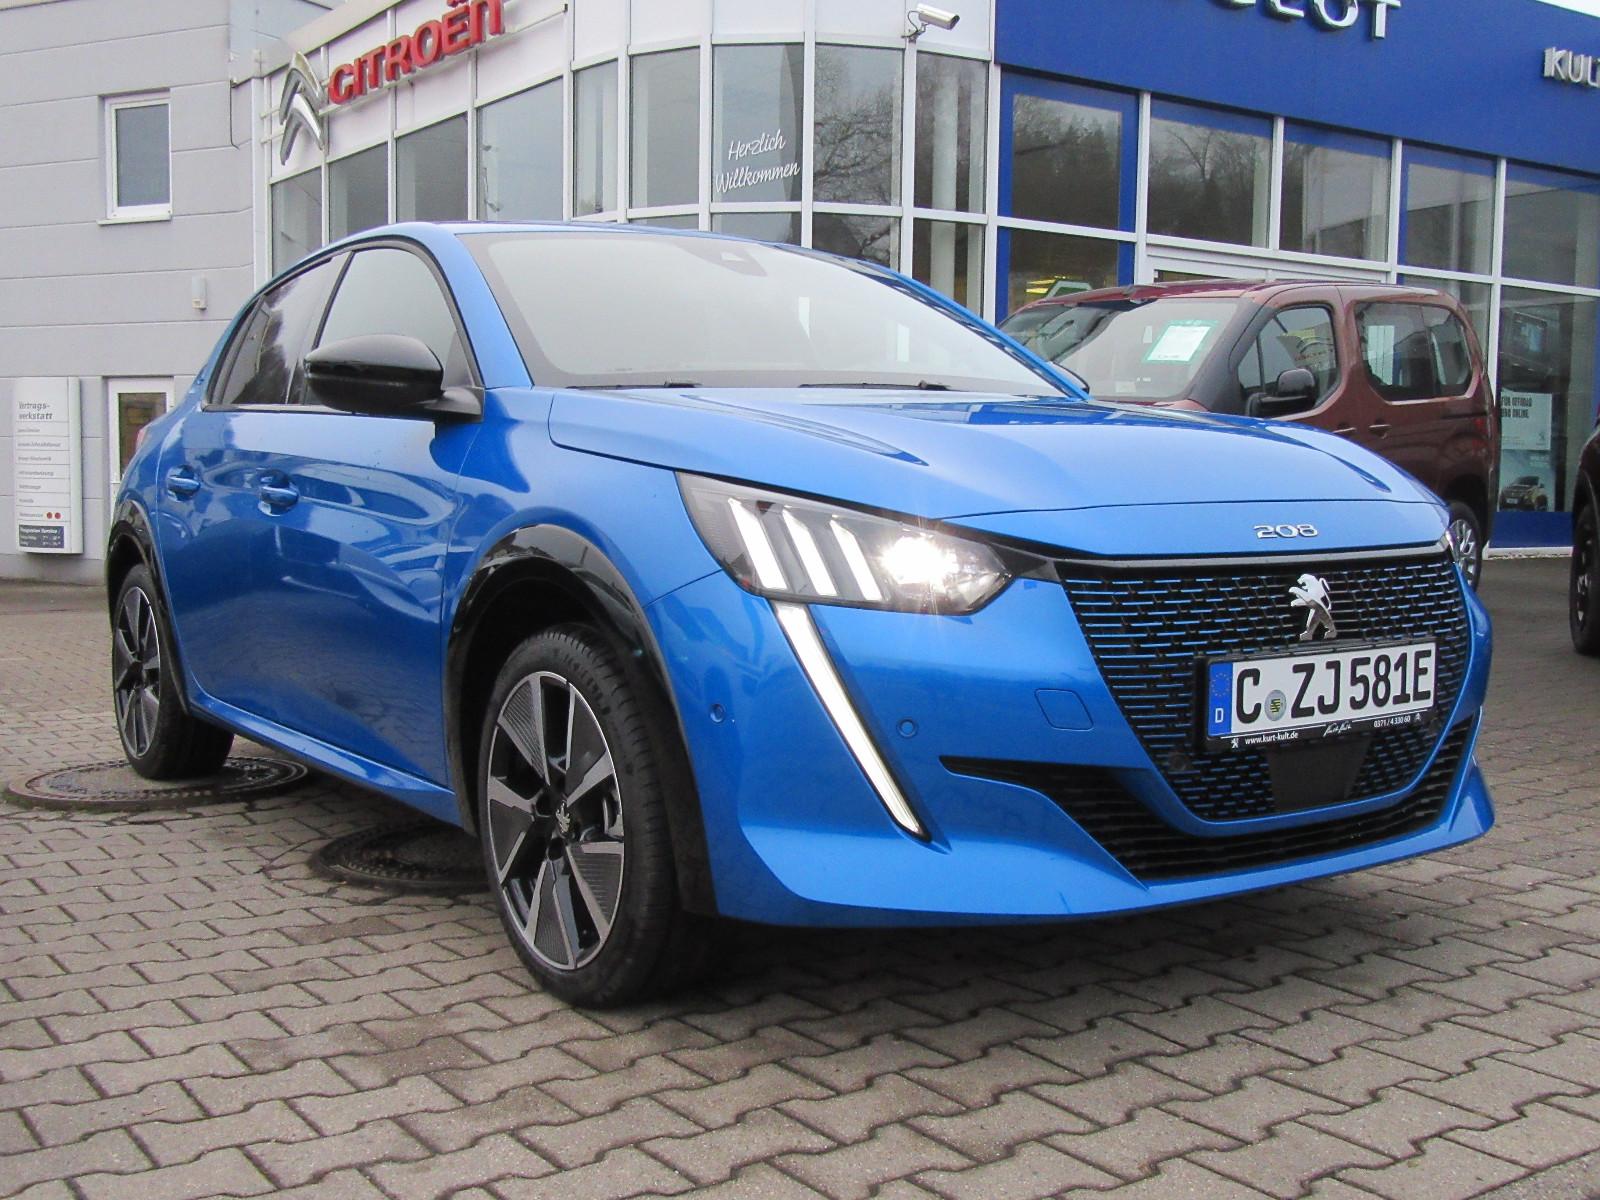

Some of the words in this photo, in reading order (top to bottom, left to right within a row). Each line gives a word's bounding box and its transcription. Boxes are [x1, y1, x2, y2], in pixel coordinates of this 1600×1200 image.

[1543, 46, 1600, 88] KUL
[728, 129, 786, 160] Herzlich
[715, 162, 800, 193] Willkommen
[1254, 523, 1318, 539] 208
[1235, 667, 1262, 724] C
[1214, 707, 1225, 724] D
[1245, 731, 1299, 746] www.kurt-kult.de
